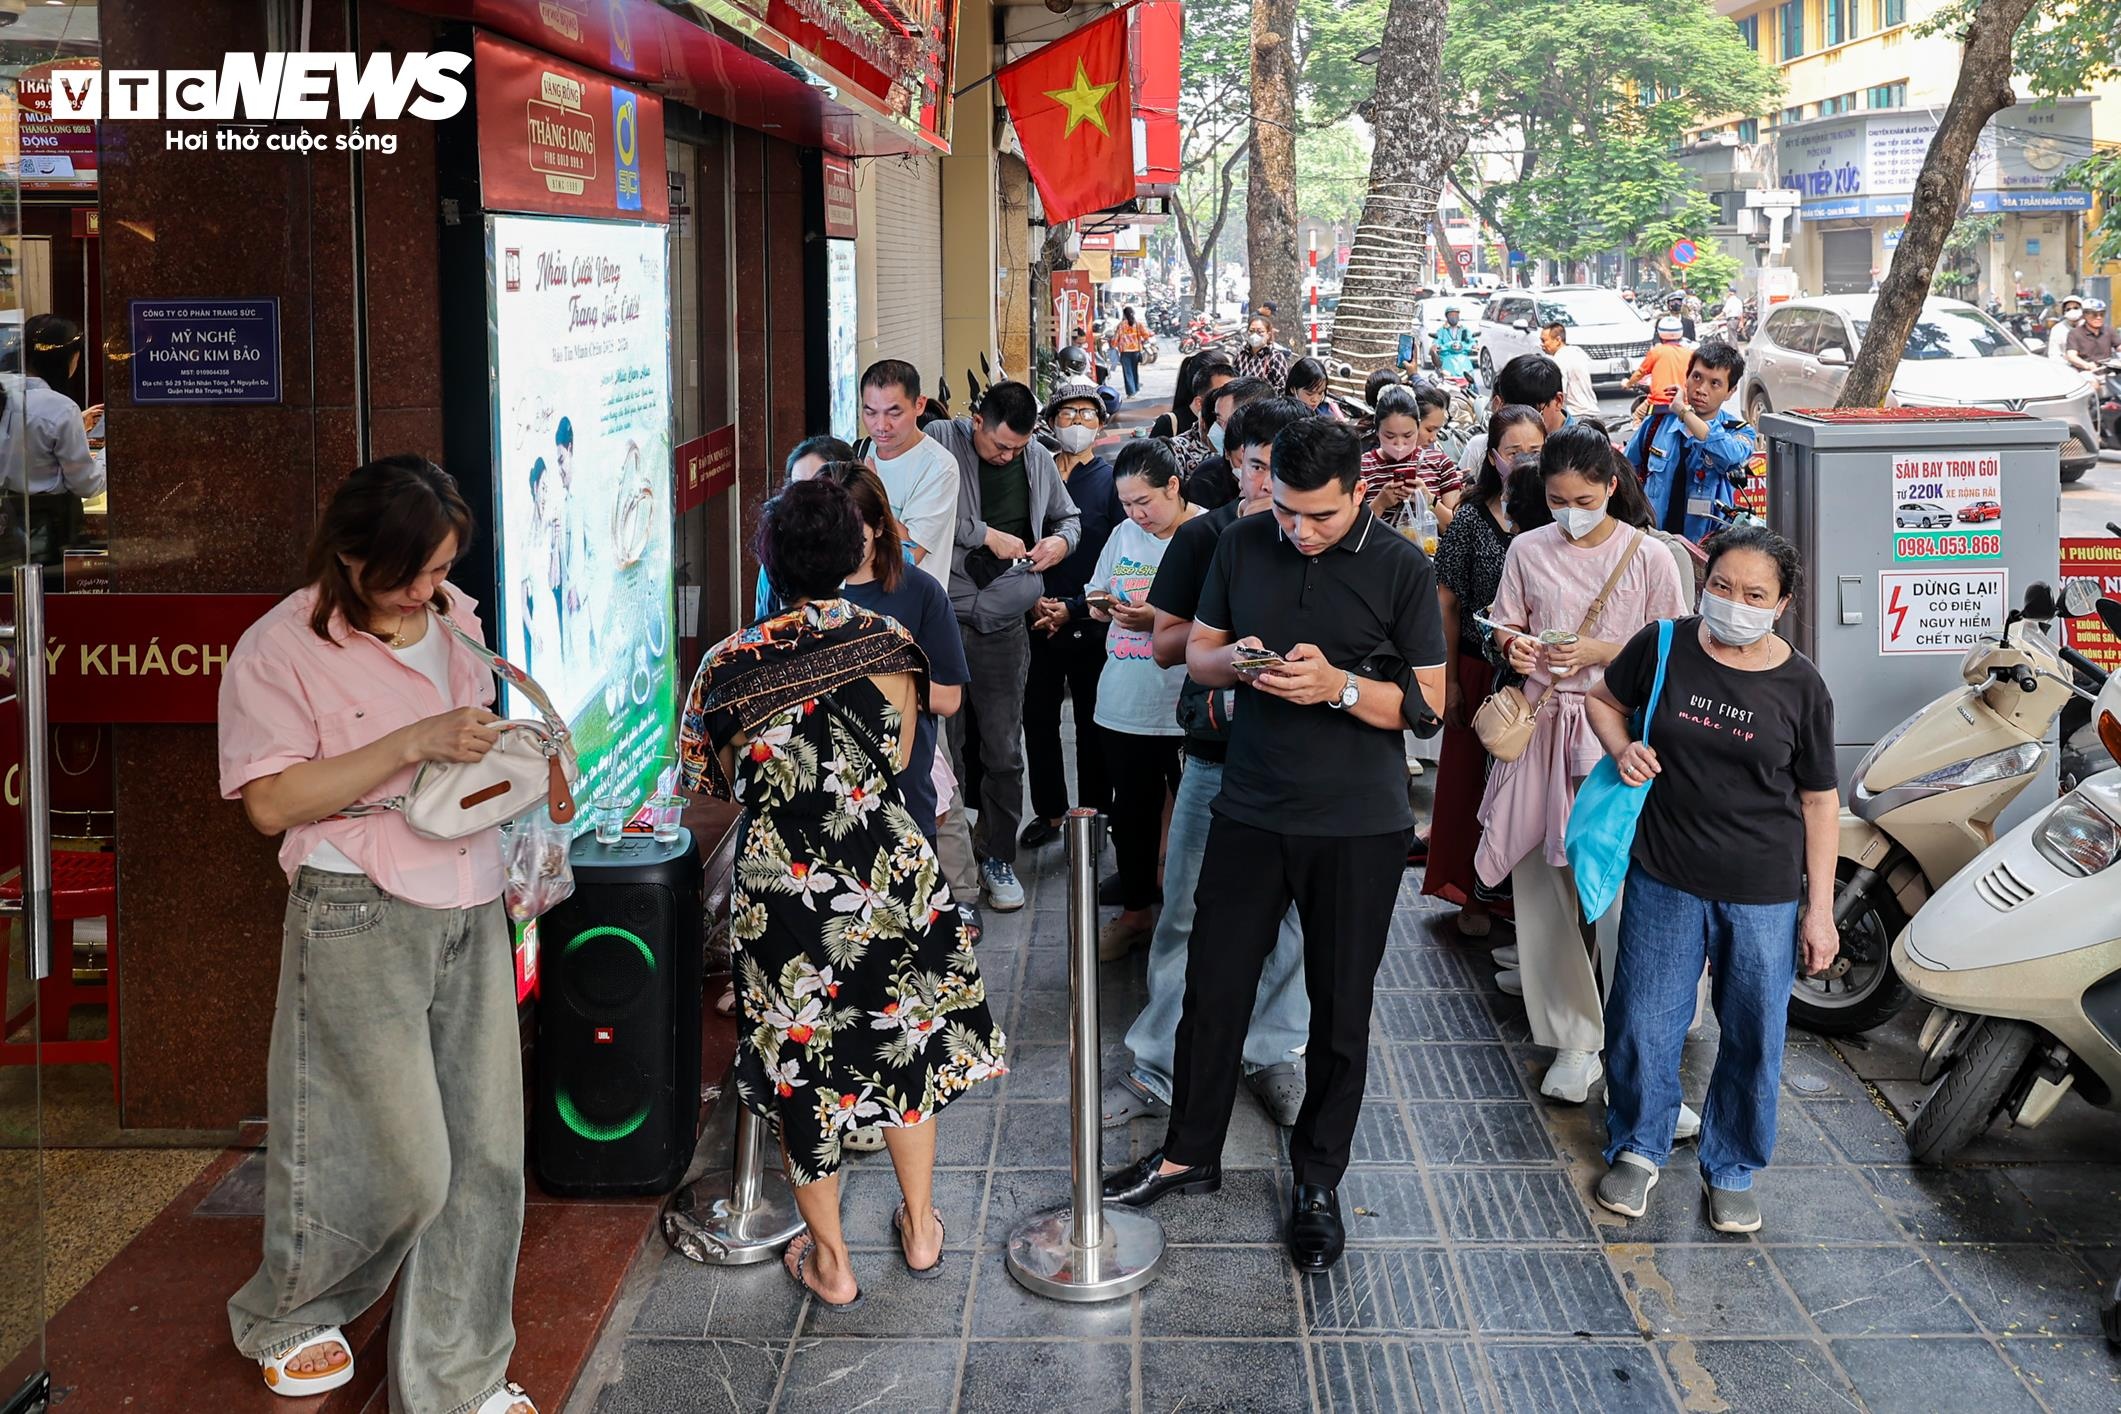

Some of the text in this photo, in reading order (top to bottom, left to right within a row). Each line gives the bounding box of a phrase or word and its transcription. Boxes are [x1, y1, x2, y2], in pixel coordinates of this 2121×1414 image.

[22, 136, 58, 148] ĐỘNG
[529, 116, 593, 154] THĂNG LONG
[1807, 159, 1833, 196] TIẾP
[1835, 161, 1860, 194] XÚC
[2020, 194, 2041, 207] TRẦN
[2041, 197, 2062, 206] NHÂN
[2063, 195, 2085, 206] TÔNG
[143, 310, 165, 318] CÔNG
[212, 309, 238, 317] TRANG
[240, 308, 256, 317] SỨC
[568, 294, 598, 333] Trang
[171, 328, 237, 346] MỸ NGHỆ
[149, 345, 261, 362] HOÀNG KIM BẢO
[1922, 461, 1943, 478] BAY
[1945, 460, 1976, 481] TRỌN
[1978, 456, 1998, 477] GÓI
[1908, 484, 1943, 500] 220K
[1946, 489, 1956, 498] XE
[1897, 536, 2000, 557] 0984.053.868
[2069, 545, 2121, 560] PHƯỜNG
[1913, 579, 1998, 599] DỪNG LẠI!
[1929, 598, 1981, 612] CÓ ĐIỆN
[1919, 612, 1991, 628] NGUY HIỂM
[1916, 631, 1951, 645] CHẾT
[80, 637, 228, 677] KHÁCH
[1690, 694, 1754, 724] BUT FIRST
[1679, 711, 1754, 742] make up
